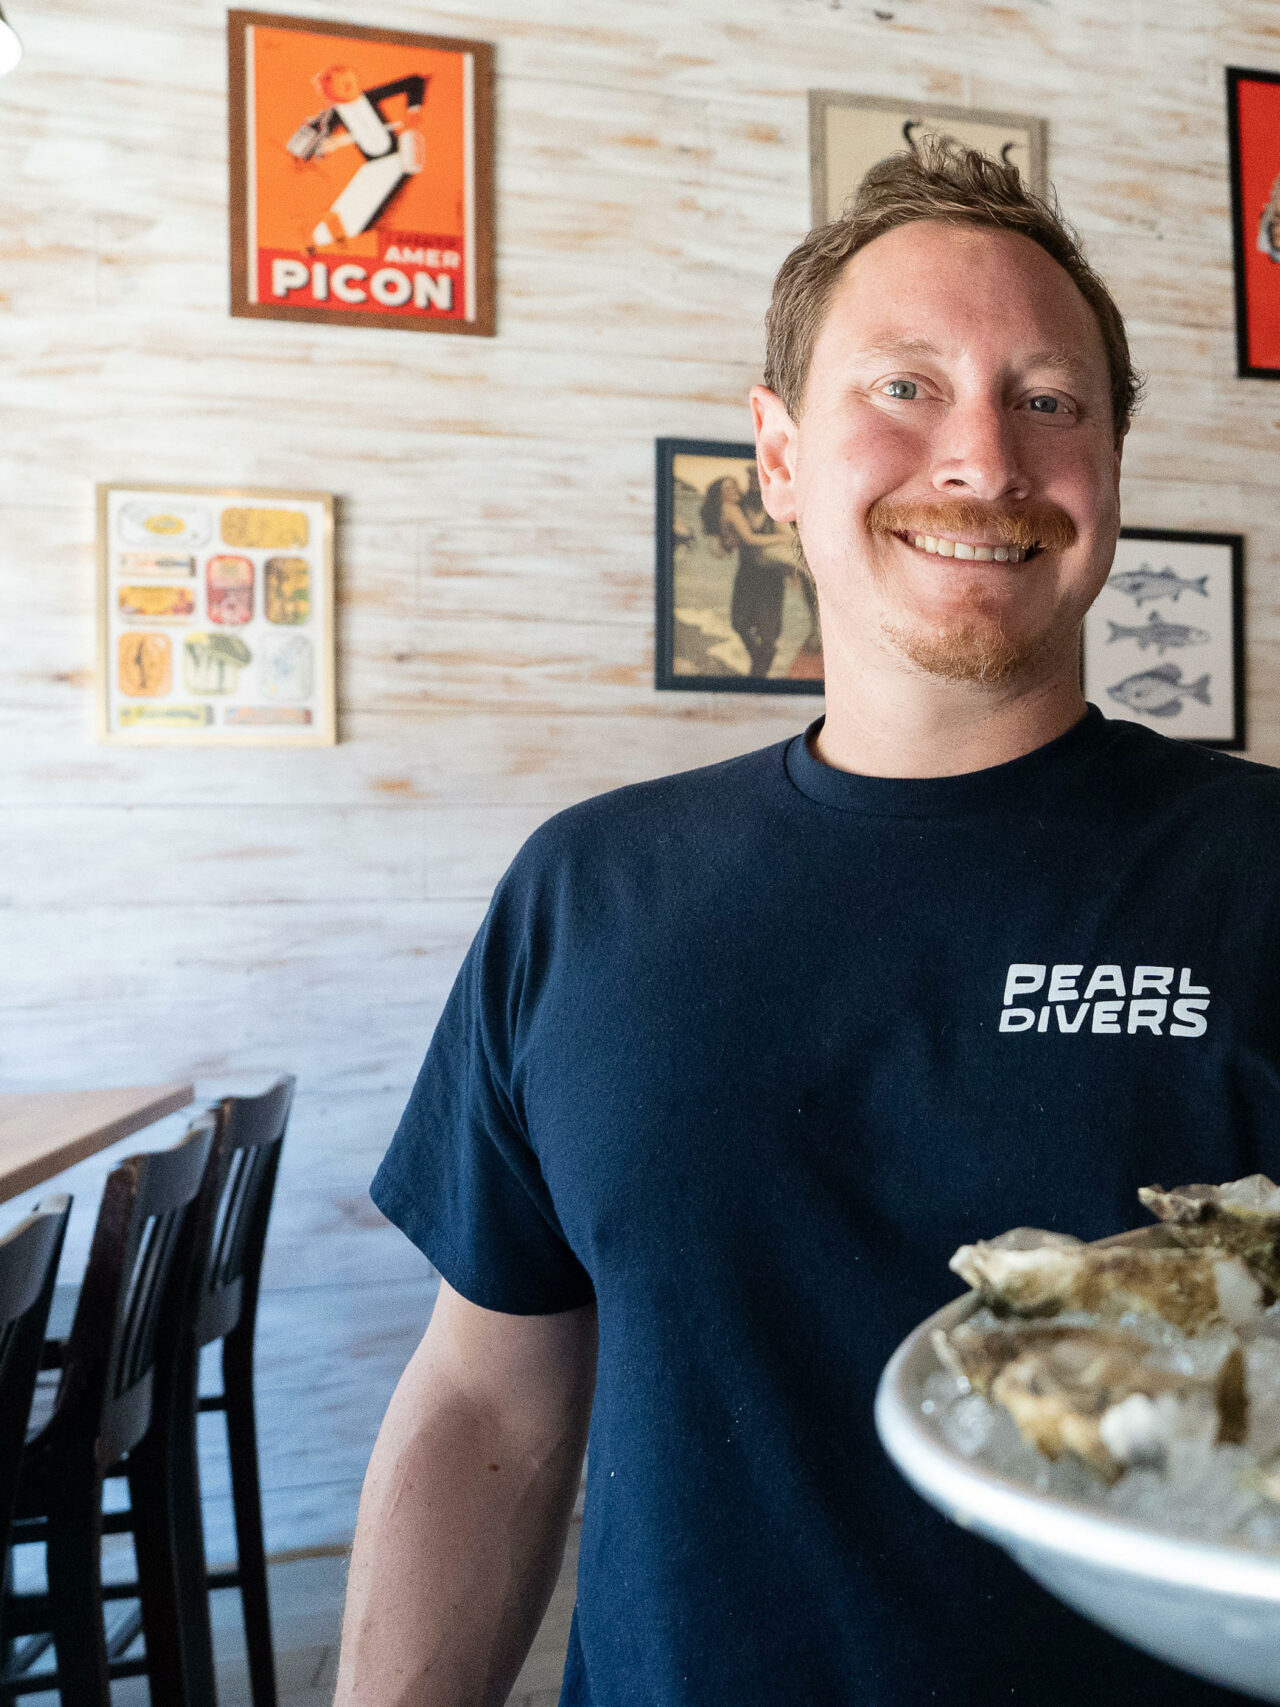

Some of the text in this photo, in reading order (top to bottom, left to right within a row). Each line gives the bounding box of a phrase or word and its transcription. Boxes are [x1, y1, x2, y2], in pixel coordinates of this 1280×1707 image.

[383, 246, 461, 269] AMER
[271, 259, 455, 310] PICON
[1003, 963, 1211, 1005] PEARL
[998, 998, 1211, 1038] DIVERS
